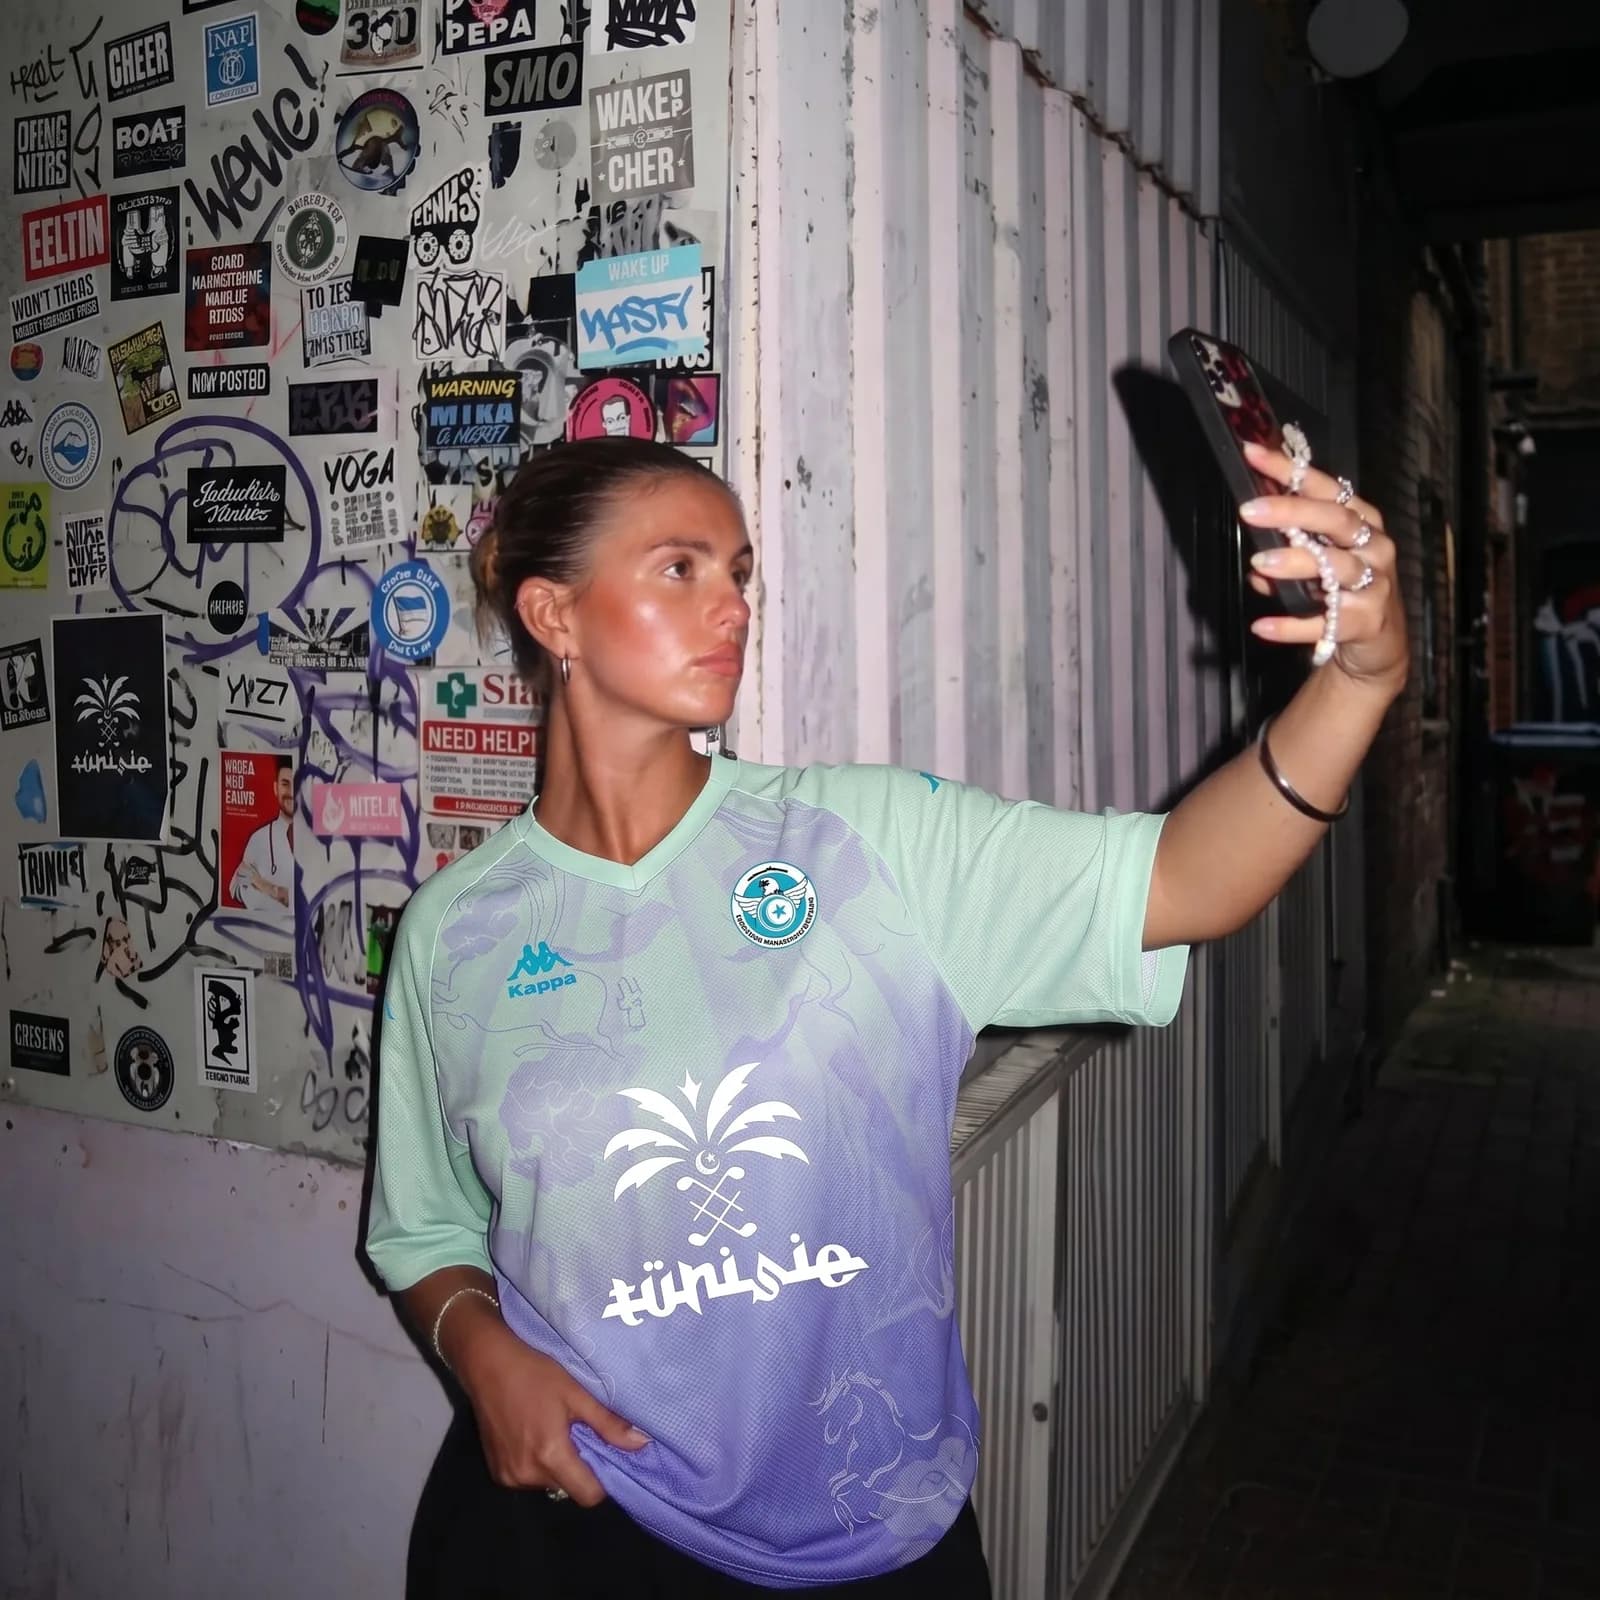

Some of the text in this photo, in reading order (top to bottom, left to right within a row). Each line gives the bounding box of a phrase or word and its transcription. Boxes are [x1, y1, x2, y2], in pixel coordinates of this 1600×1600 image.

[446, 9, 532, 48] PEPA
[108, 31, 170, 90] CHEER
[490, 51, 578, 108] SMO
[596, 81, 669, 132] WAKE
[117, 117, 182, 150] BOAT
[608, 147, 675, 193] CHER
[28, 205, 105, 271] EELTIN
[608, 253, 670, 281] WAKE UP
[12, 288, 51, 322] WON'T
[431, 379, 516, 398] WARNING
[430, 402, 514, 427] MIKA
[323, 447, 395, 495] YOGA
[428, 727, 477, 750] NEED
[507, 971, 577, 1000] Kappa
[601, 1232, 870, 1327] tünisie
